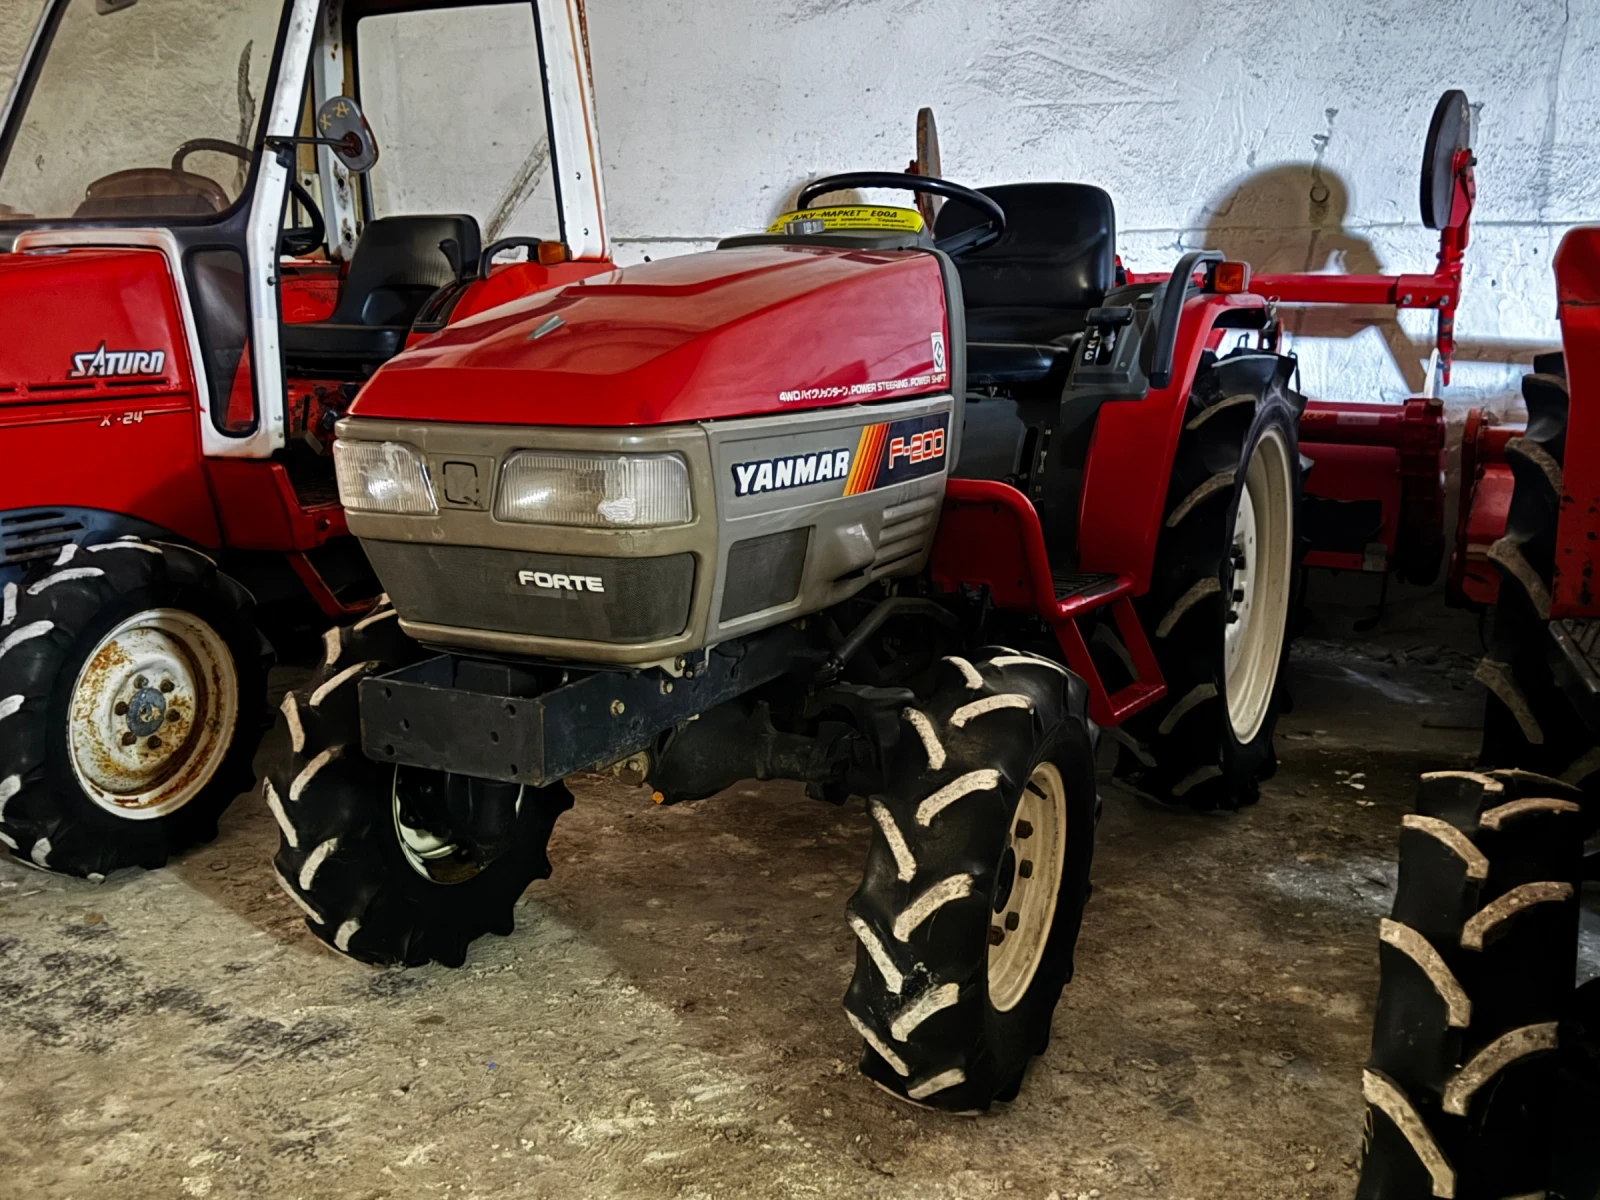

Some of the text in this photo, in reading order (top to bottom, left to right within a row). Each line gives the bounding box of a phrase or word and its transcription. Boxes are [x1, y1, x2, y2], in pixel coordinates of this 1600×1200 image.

[69, 343, 166, 378] SATURN
[888, 427, 945, 470] F-200
[734, 449, 850, 496] YANMAR
[518, 570, 605, 593] FORTE
